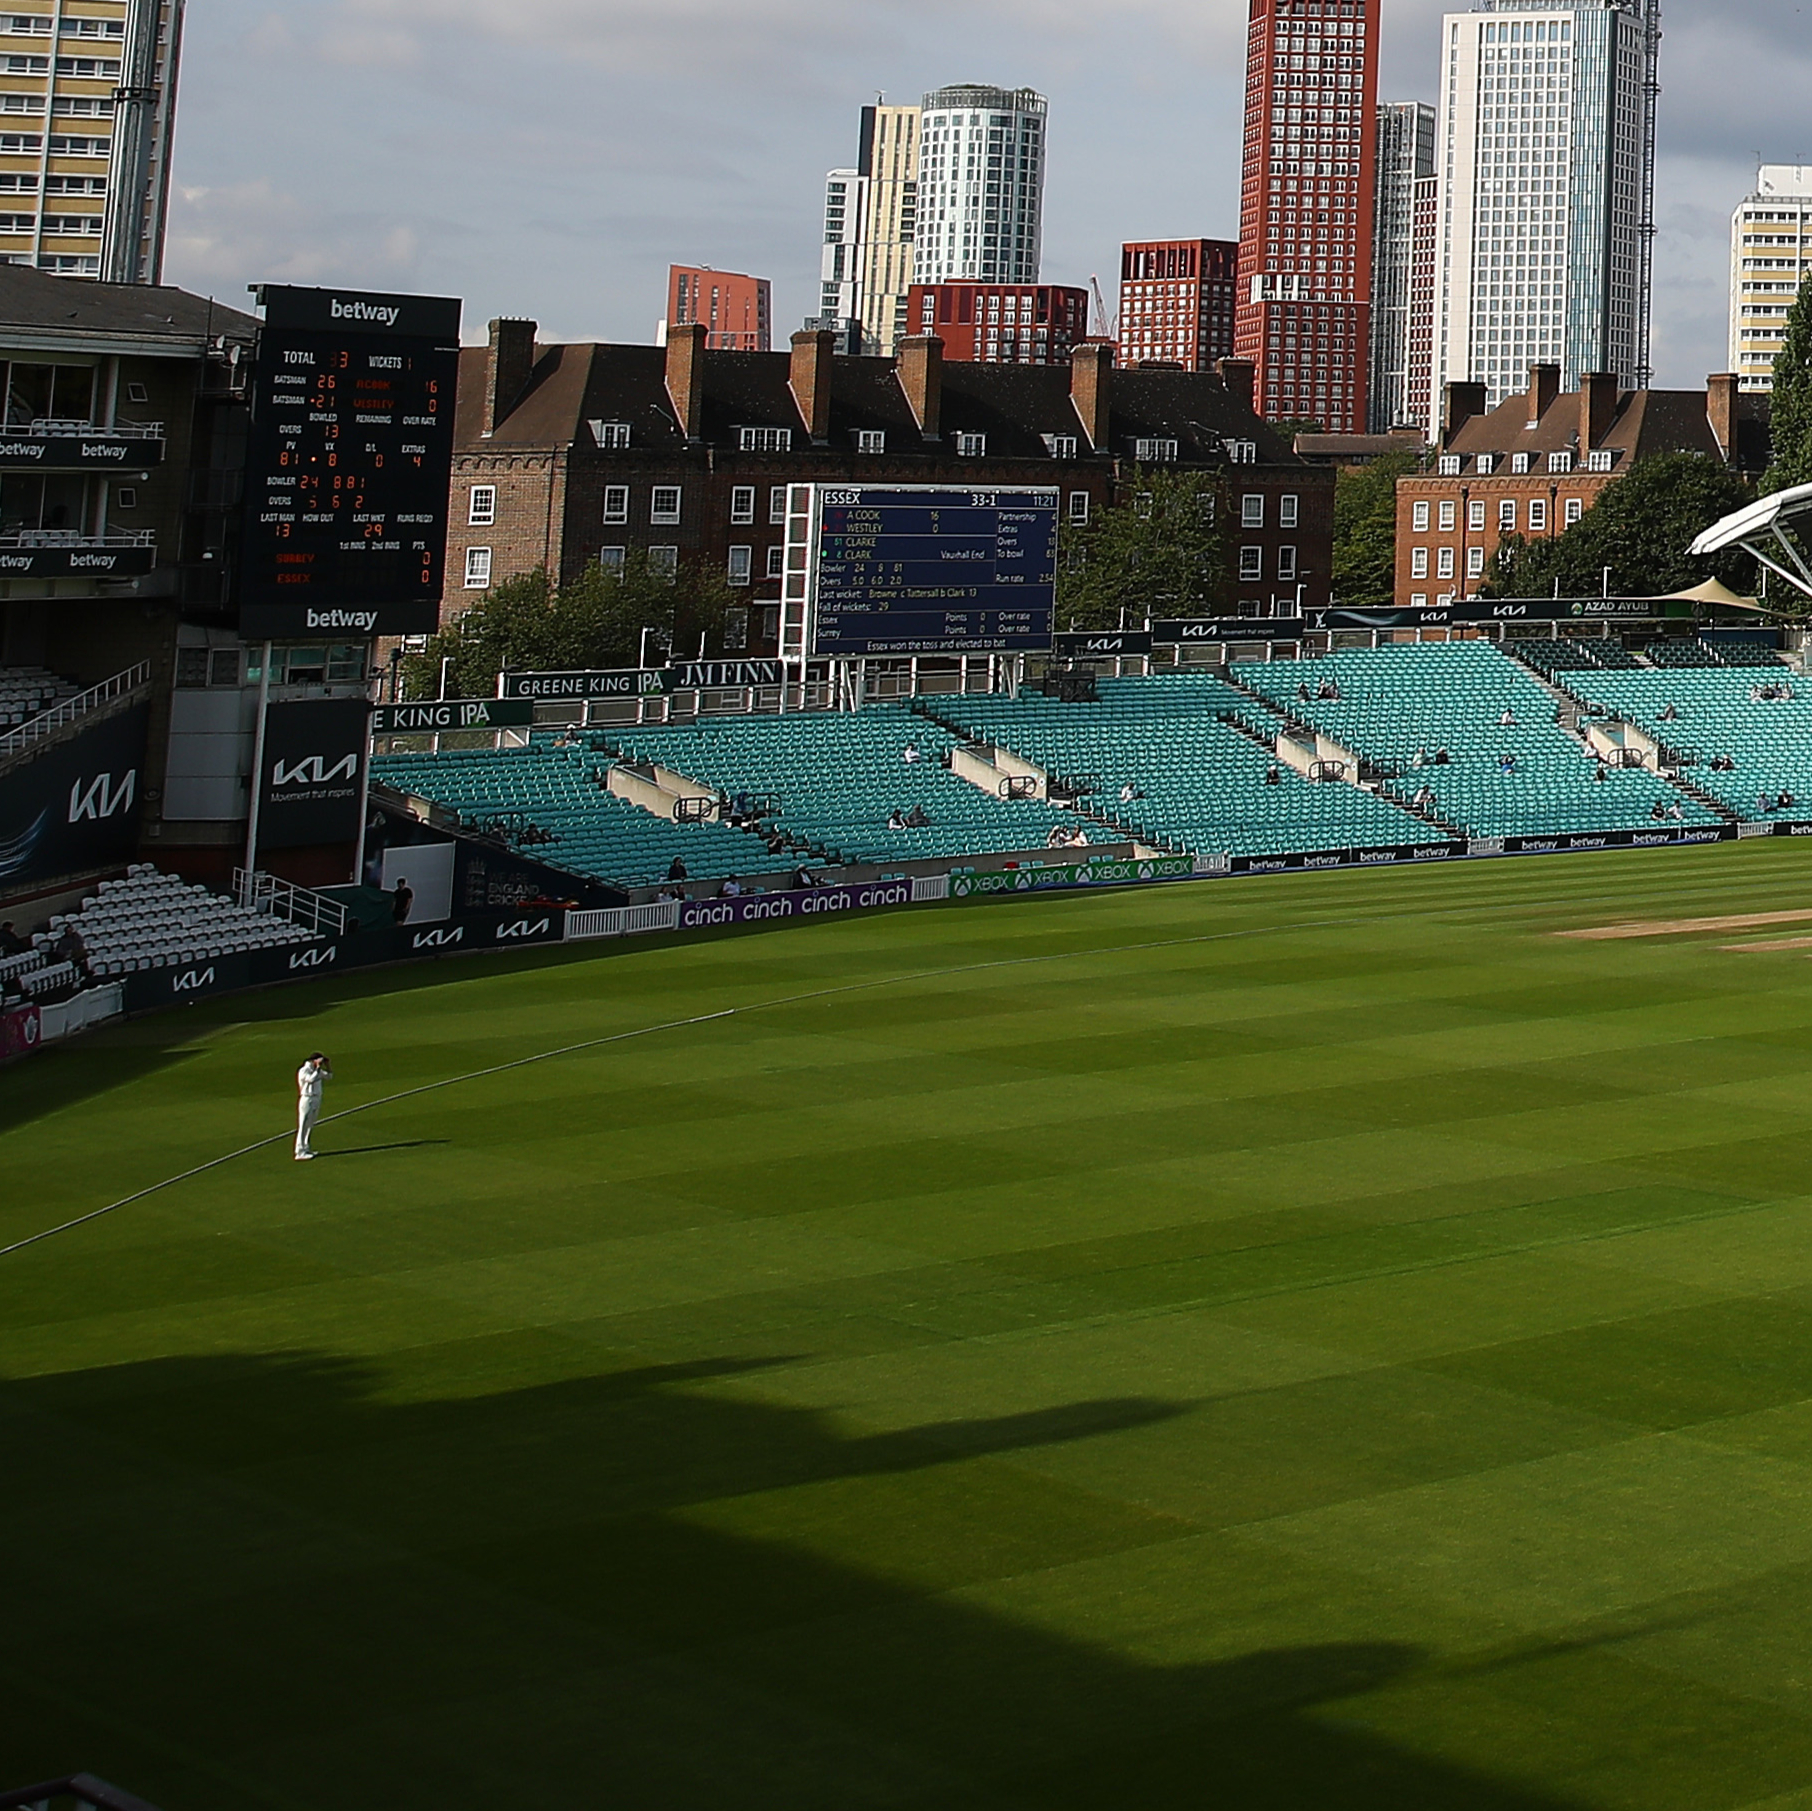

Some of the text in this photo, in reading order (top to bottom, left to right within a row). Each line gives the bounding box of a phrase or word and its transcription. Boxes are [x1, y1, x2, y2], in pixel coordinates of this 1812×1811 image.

[331, 299, 399, 326] betway
[284, 351, 316, 365] TOTAL
[369, 356, 402, 369] WICKETS
[274, 375, 335, 388] BATSMAN 26
[279, 424, 339, 438] OVERS 13
[81, 443, 128, 460] betway
[300, 475, 319, 489] 24
[268, 497, 291, 505] OVERS
[824, 491, 861, 504] ESSEX
[971, 494, 997, 506] 33-1
[854, 511, 881, 520] COOK
[999, 512, 1036, 523] Partnership
[364, 524, 382, 537] 29
[846, 524, 883, 533] WESTLEY
[998, 525, 1018, 533] Extras
[845, 537, 876, 546] CLARKE
[997, 537, 1017, 546] Overs
[70, 553, 117, 569] betway
[845, 550, 985, 559] CLARK Vauxhall End
[820, 563, 846, 572] Bowler
[820, 577, 841, 586] Overs
[1585, 601, 1649, 611] AZAD AYUB
[306, 608, 378, 631] betway
[867, 642, 888, 652] Essex
[890, 643, 907, 651] won
[909, 641, 921, 650] the
[923, 641, 938, 650] toss
[939, 640, 954, 650] and
[955, 639, 982, 649] elected
[993, 639, 1006, 648] bat
[680, 661, 777, 686] JM FINN
[518, 671, 664, 695] GREENE KING IPA
[393, 702, 490, 729] KING IPA
[271, 789, 310, 803] Movement
[311, 788, 328, 801] that
[1633, 831, 1669, 845] betway
[1684, 830, 1721, 843] betway
[1521, 838, 1558, 852] betway
[1156, 860, 1190, 875] XBOX
[1249, 859, 1286, 871] betway
[1304, 854, 1341, 868] betway
[1033, 870, 1069, 884] XBOX
[1094, 865, 1131, 880] XBOX
[974, 874, 1009, 890] XBOX
[801, 890, 850, 913] cinch
[859, 884, 908, 907] cinch
[684, 902, 734, 926] cinch
[743, 896, 792, 920] cinch
